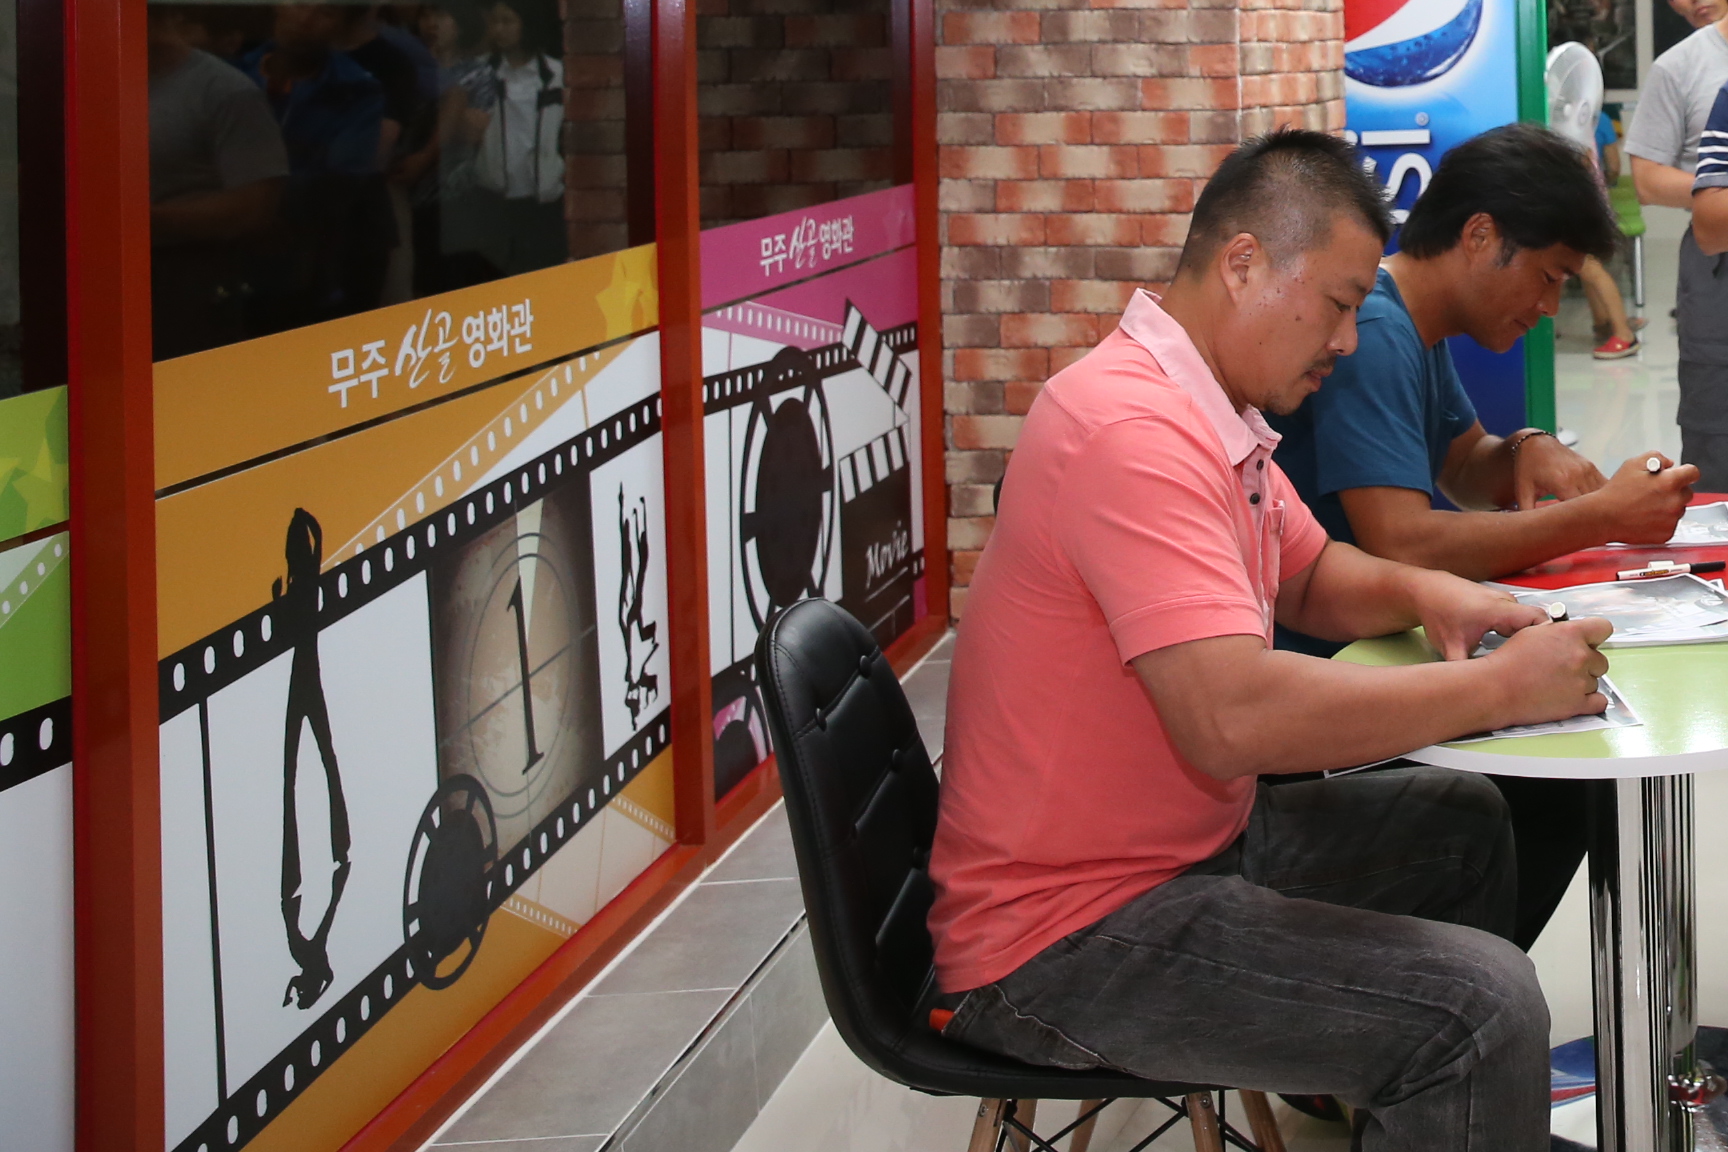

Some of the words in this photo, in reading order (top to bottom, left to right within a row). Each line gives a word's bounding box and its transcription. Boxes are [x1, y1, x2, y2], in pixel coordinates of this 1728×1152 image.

[759, 233, 788, 278] 무주
[327, 339, 390, 410] 무주
[461, 298, 535, 369] 영화관
[864, 519, 910, 591] Movie
[506, 575, 546, 776] 1
